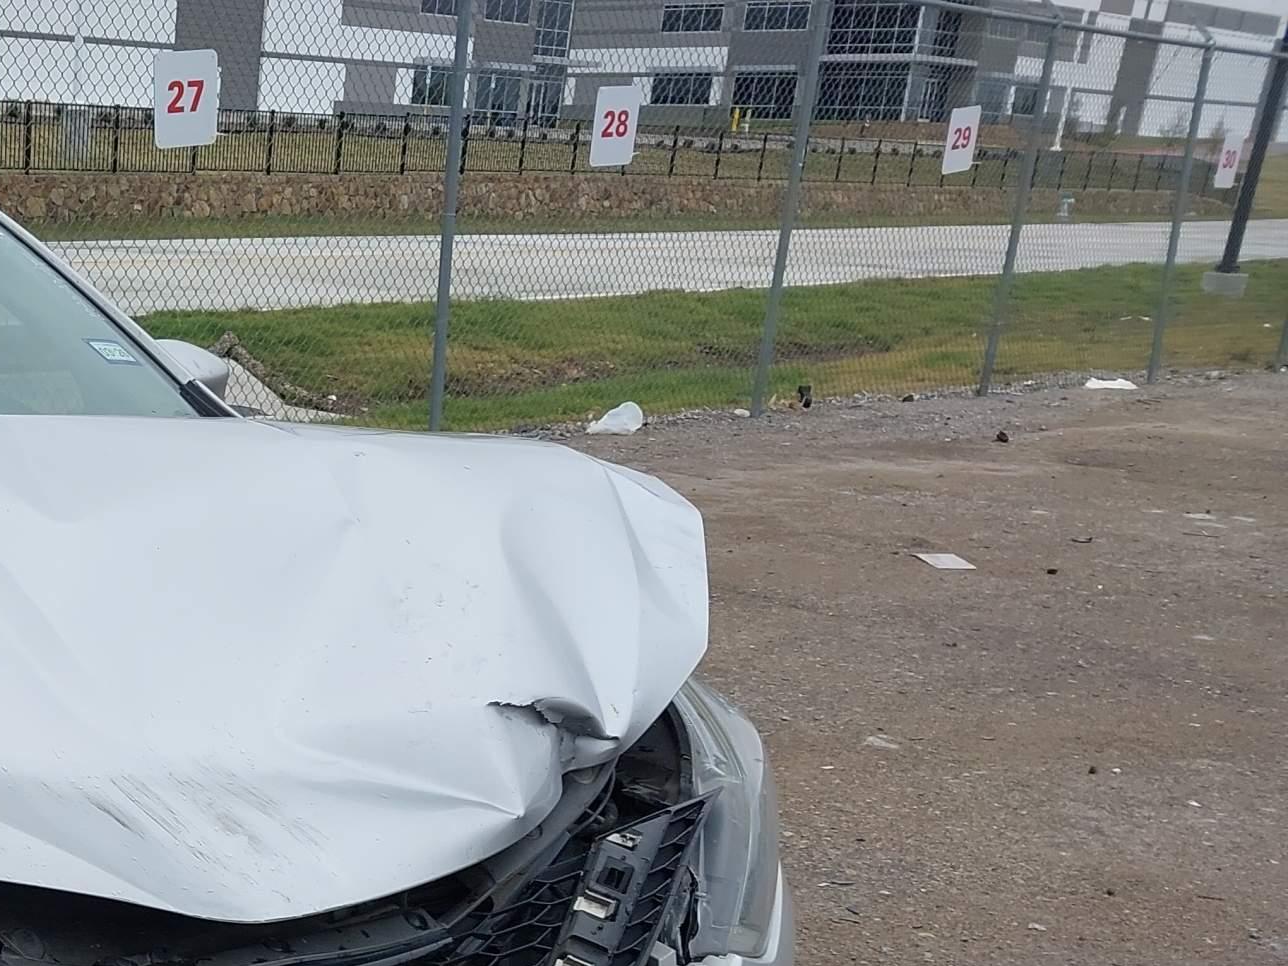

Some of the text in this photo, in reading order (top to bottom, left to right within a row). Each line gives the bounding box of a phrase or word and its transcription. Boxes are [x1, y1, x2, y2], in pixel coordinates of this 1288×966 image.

[166, 79, 204, 114] 27
[601, 109, 629, 139] 28
[951, 125, 973, 152] 29
[1222, 150, 1238, 169] 30
